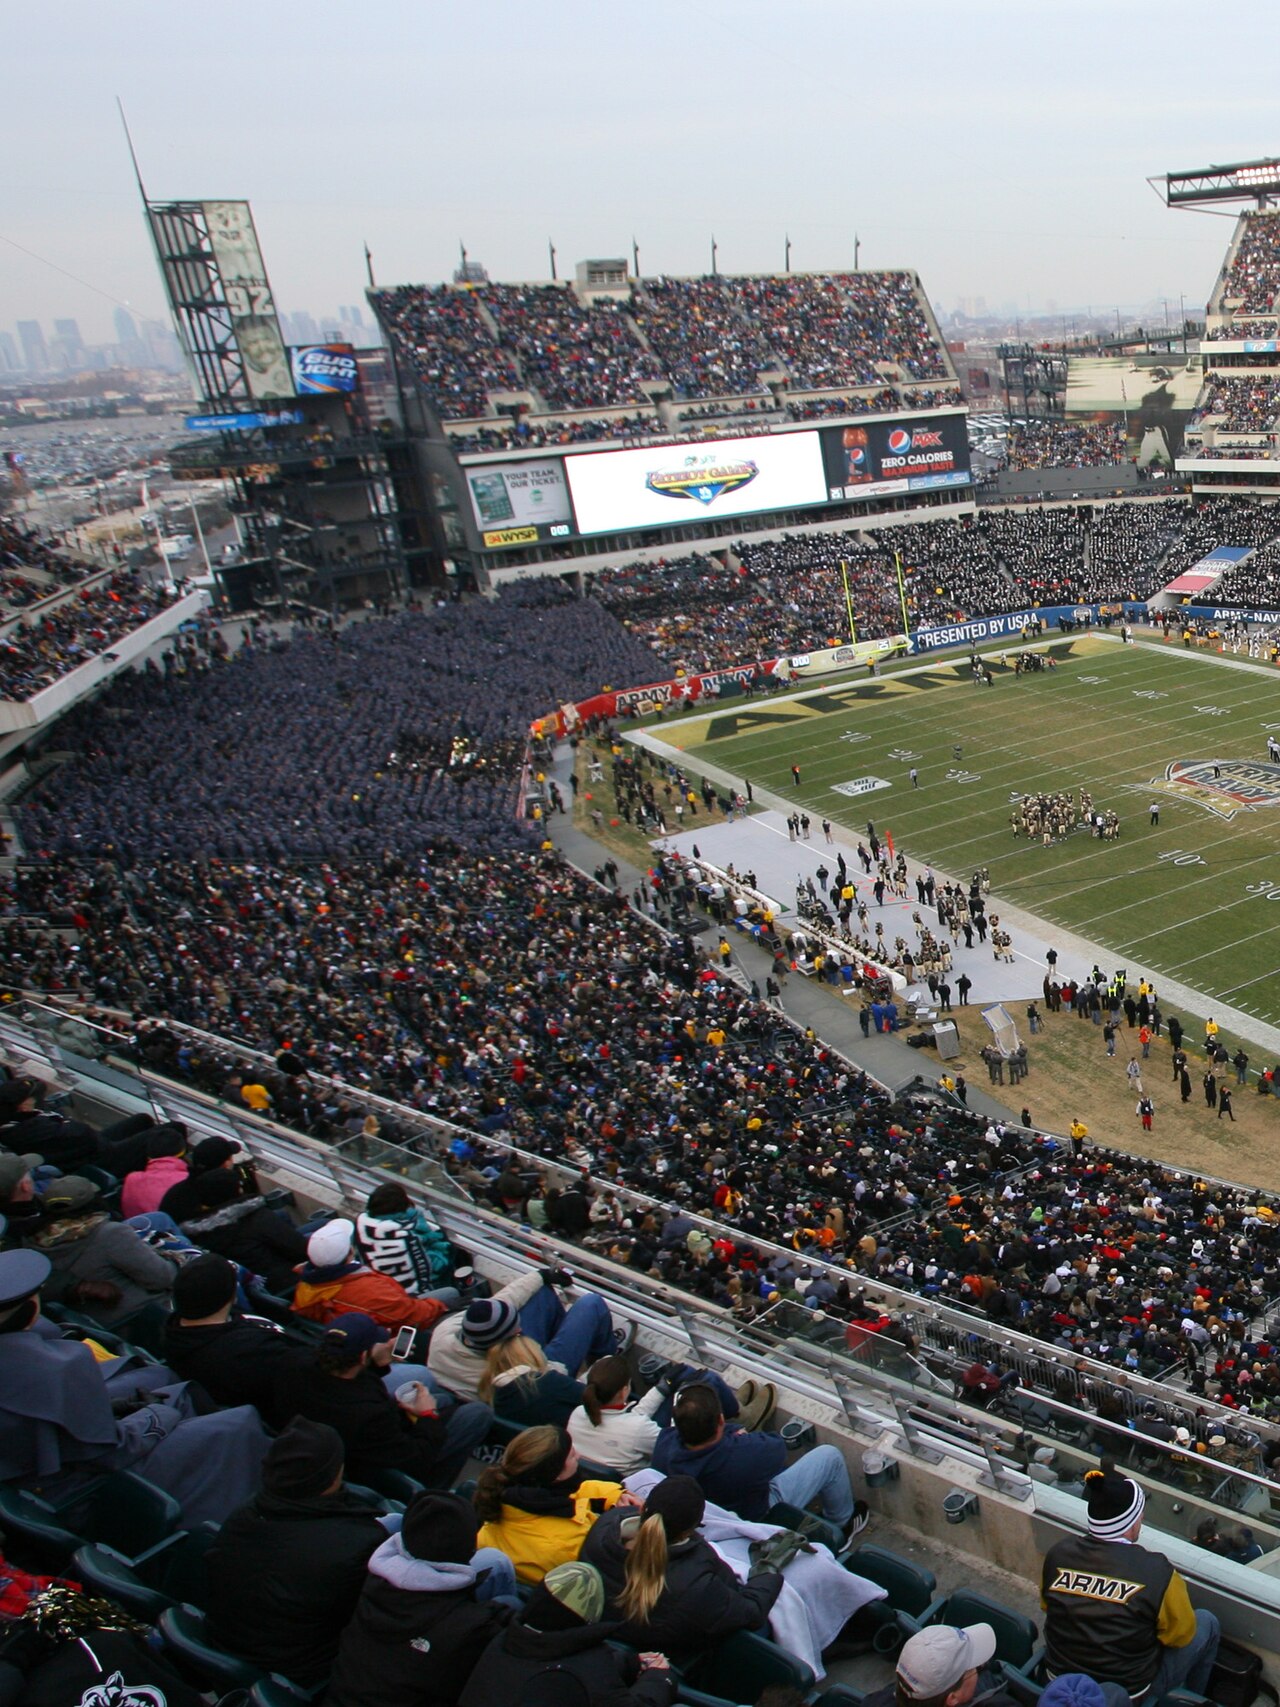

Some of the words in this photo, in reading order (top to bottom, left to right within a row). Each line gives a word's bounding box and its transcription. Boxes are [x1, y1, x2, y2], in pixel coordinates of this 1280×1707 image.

[224, 285, 276, 316] 92
[304, 352, 356, 369] BUD
[298, 363, 358, 378] LIGHT
[911, 431, 943, 448] MAX
[881, 458, 906, 468] ZERO
[907, 451, 953, 465] CALORIES
[504, 471, 529, 481] YOUR
[882, 465, 928, 477] MAXIMUM
[930, 461, 955, 472] TASTE
[510, 480, 529, 489] OUR
[917, 622, 987, 651] PRESENTED
[989, 618, 1004, 636] BY
[1007, 613, 1038, 631] USAA
[614, 685, 673, 712] ARMY
[839, 731, 872, 743] 10
[945, 769, 982, 784] 30
[1185, 771, 1274, 799] NAVY
[1156, 848, 1202, 866] 40
[1052, 1571, 1139, 1602] ARMY
